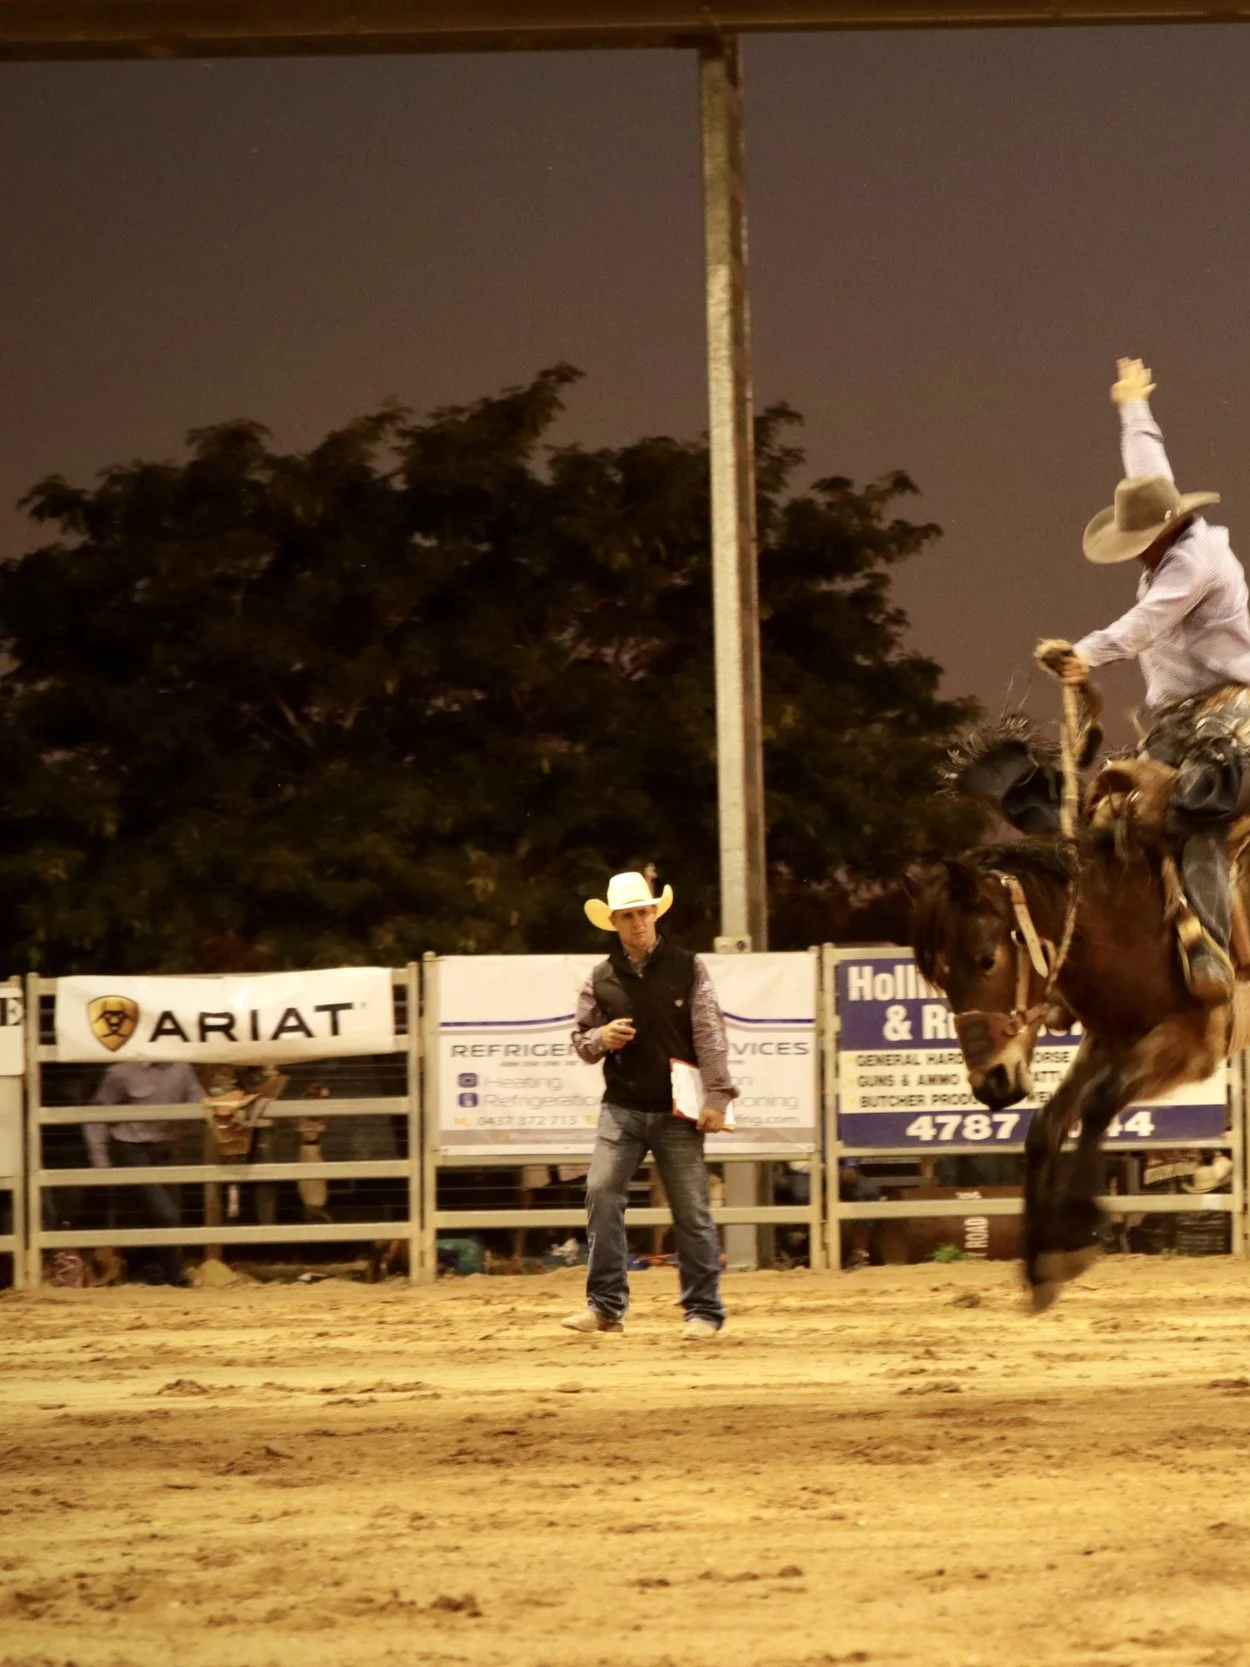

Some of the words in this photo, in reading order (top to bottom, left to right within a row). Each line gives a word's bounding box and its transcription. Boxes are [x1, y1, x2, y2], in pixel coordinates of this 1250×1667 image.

[148, 1002, 354, 1043] ARIAT
[883, 1004, 913, 1041] &
[450, 1043, 577, 1058] REFRIGE
[730, 1042, 810, 1056] VICES
[857, 1052, 920, 1067] GENERAL
[925, 1052, 964, 1066] HARD
[1034, 1050, 1070, 1064] ORSE
[857, 1074, 895, 1088] GUNS
[917, 1073, 960, 1086] AMMO
[483, 1094, 601, 1110] Refrigeratio
[860, 1094, 925, 1109] BUTCHER
[930, 1093, 979, 1106] PRODU
[905, 1113, 1020, 1141] 4787
